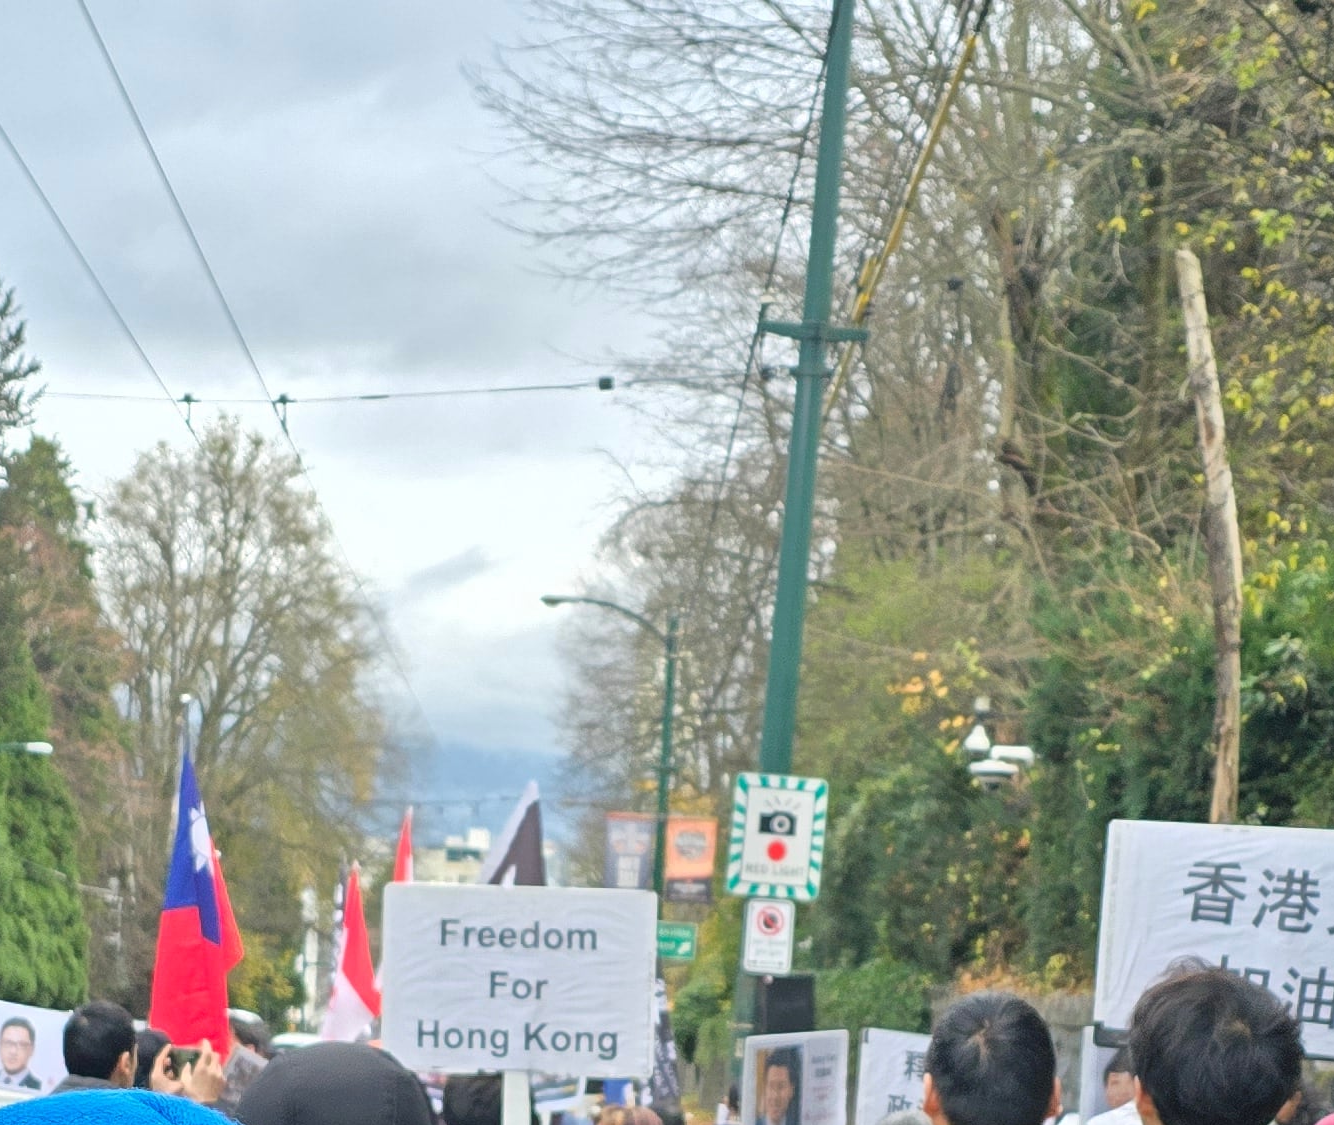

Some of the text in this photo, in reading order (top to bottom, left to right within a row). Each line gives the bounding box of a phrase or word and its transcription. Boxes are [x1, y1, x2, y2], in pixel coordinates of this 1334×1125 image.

[439, 918, 598, 950] Freedom
[489, 970, 549, 1000] For
[417, 1018, 618, 1061] Hong Kong
